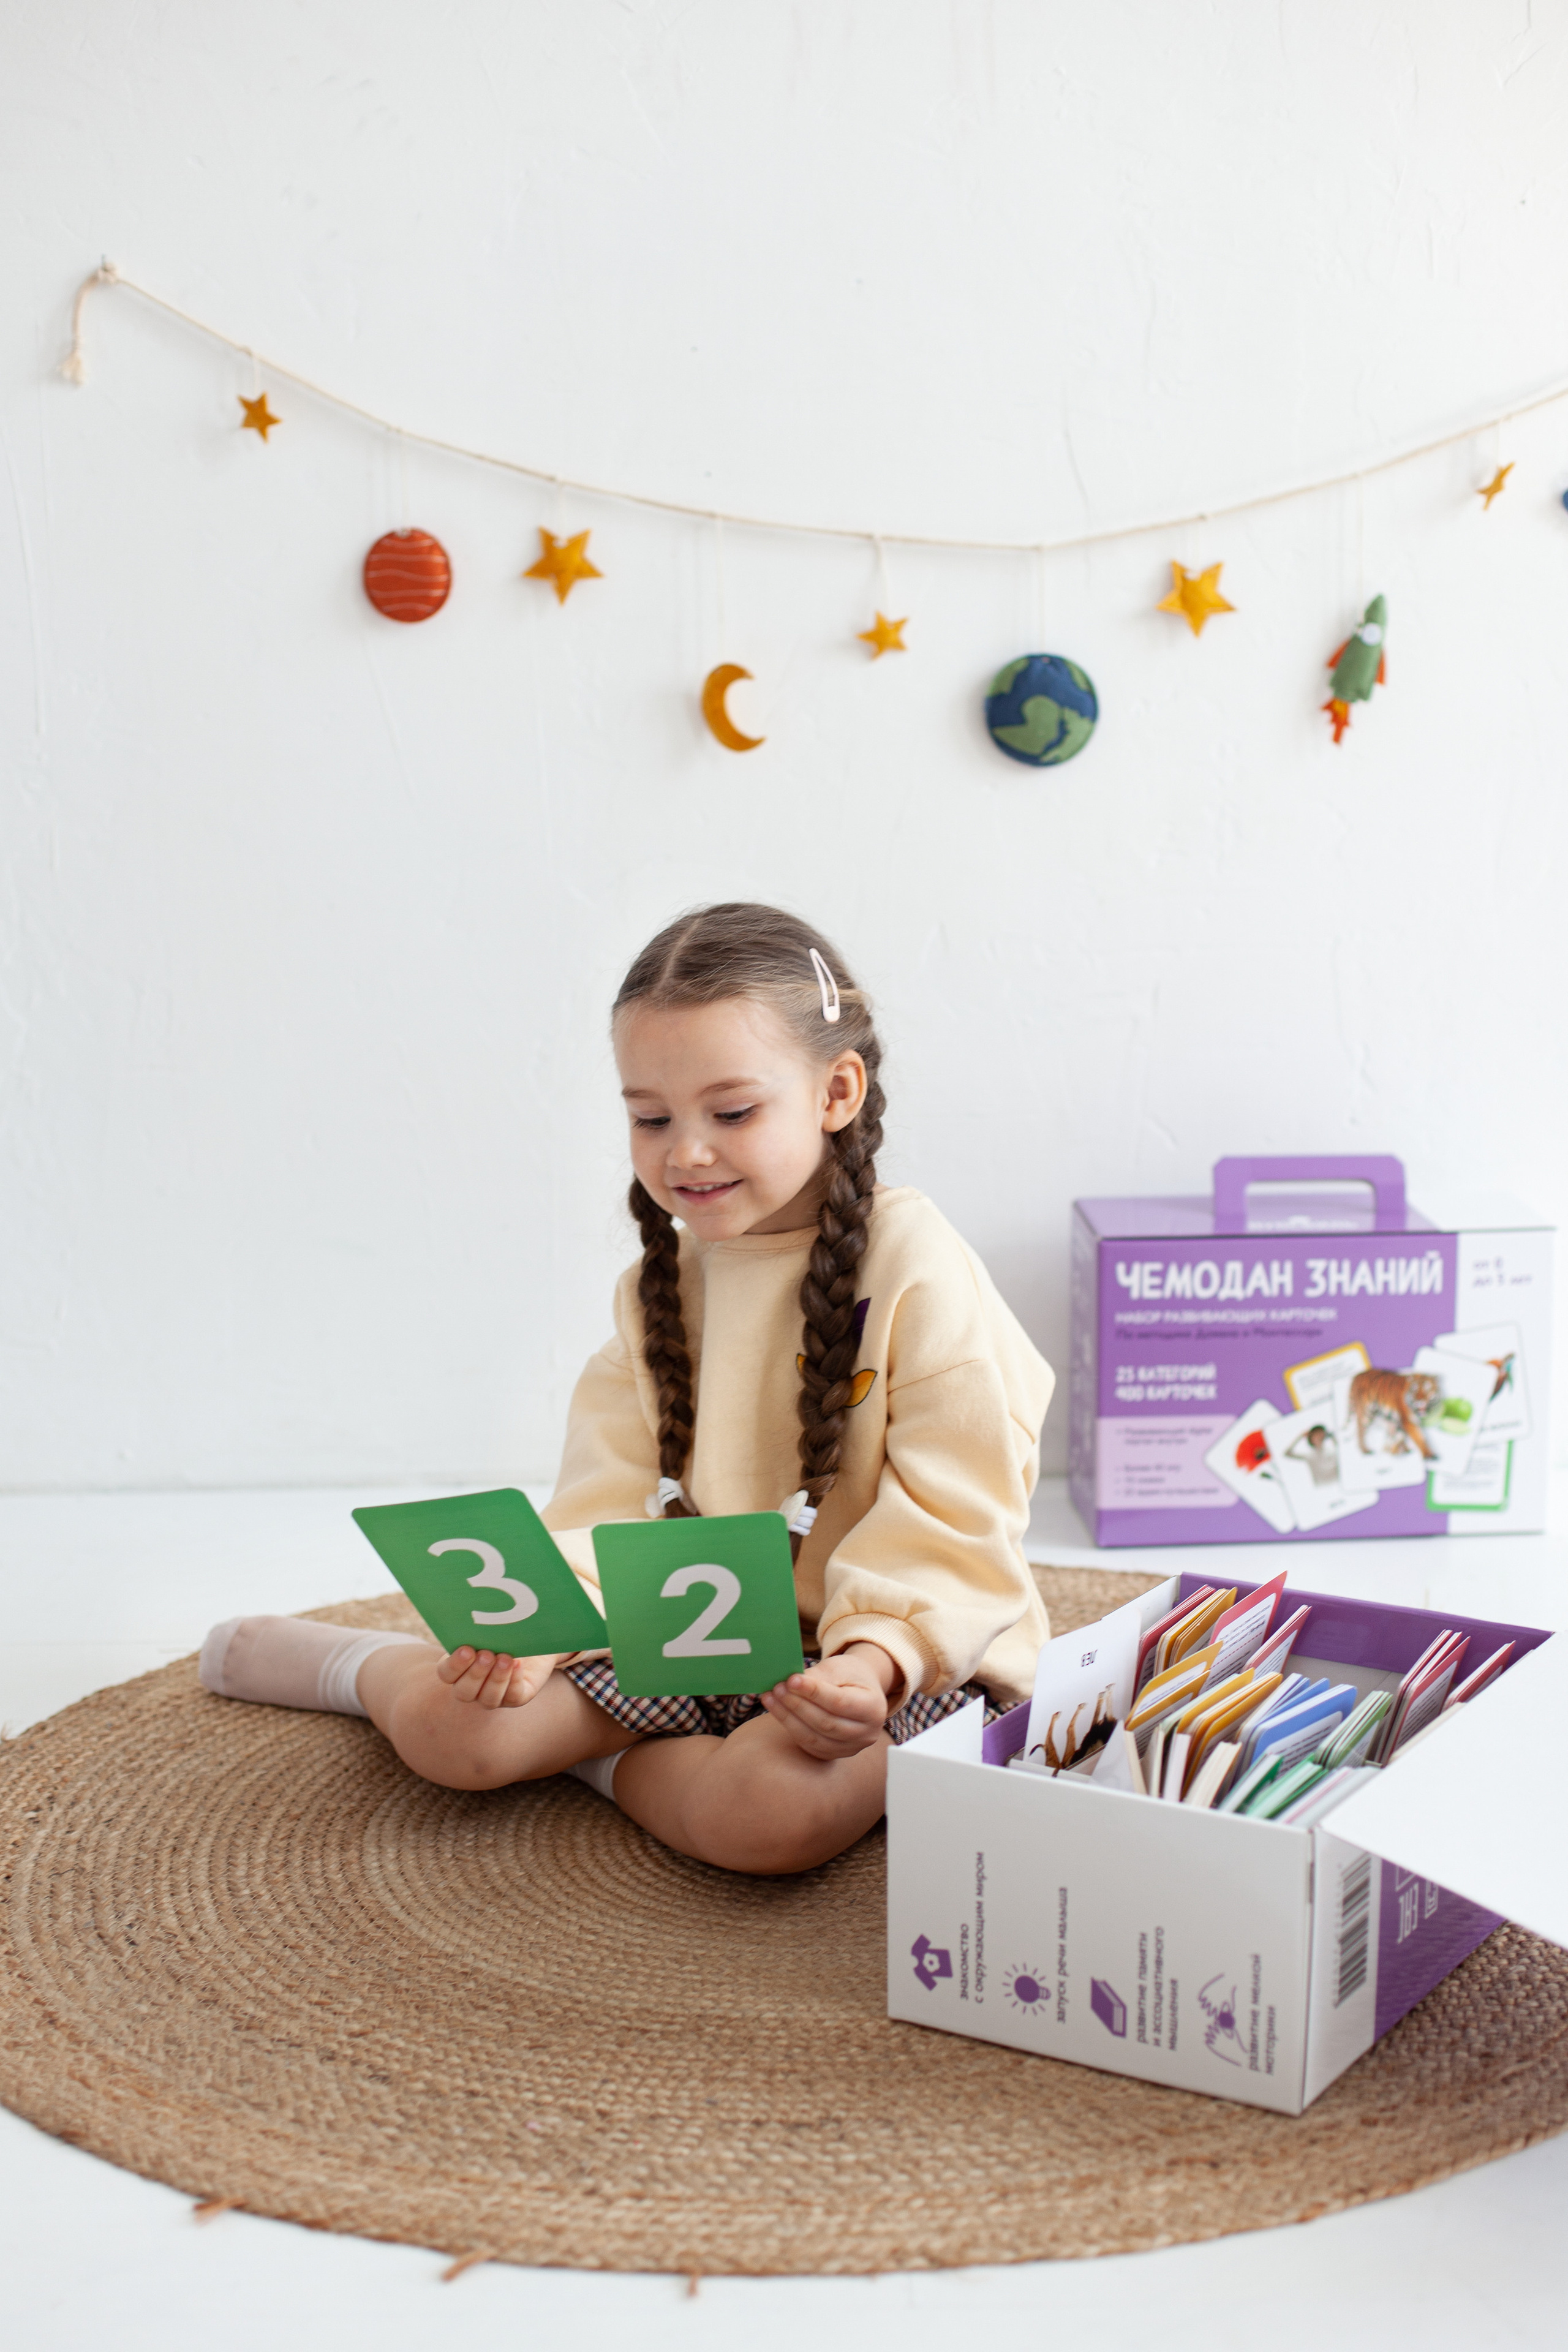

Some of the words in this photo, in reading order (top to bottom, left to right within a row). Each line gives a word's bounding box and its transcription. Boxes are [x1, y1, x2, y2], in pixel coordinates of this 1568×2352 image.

[1115, 1260, 1294, 1301] ЧЕМОДАН
[1303, 1250, 1444, 1298] ЗНАНИЙ
[1115, 1310, 1161, 1325] НАБОР
[1270, 1307, 1338, 1322] КАРТОЧЕК
[1137, 1361, 1218, 1382] КАТЕГОРИЙ
[1146, 1383, 1218, 1401] КАРТОЧЕК
[427, 1537, 539, 1625] 3
[660, 1563, 752, 1657] 2
[975, 1852, 987, 1897] миром
[1058, 1887, 1068, 1940] малыша
[960, 1923, 969, 2000] знакомство
[974, 1901, 986, 1992] окружающим
[1057, 1944, 1069, 1977] речи
[1138, 1932, 1148, 1981] памяти
[1057, 1981, 1069, 2024] запуск
[1153, 1926, 1164, 2035] ассоциативного
[1248, 1954, 1261, 2006] мелкой
[1137, 1984, 1148, 2045] развитие
[1168, 1978, 1178, 2052] мышления
[1249, 2009, 1260, 2071] развитие
[1265, 2005, 1278, 2076] моторики
[1153, 2038, 1161, 2047] и
